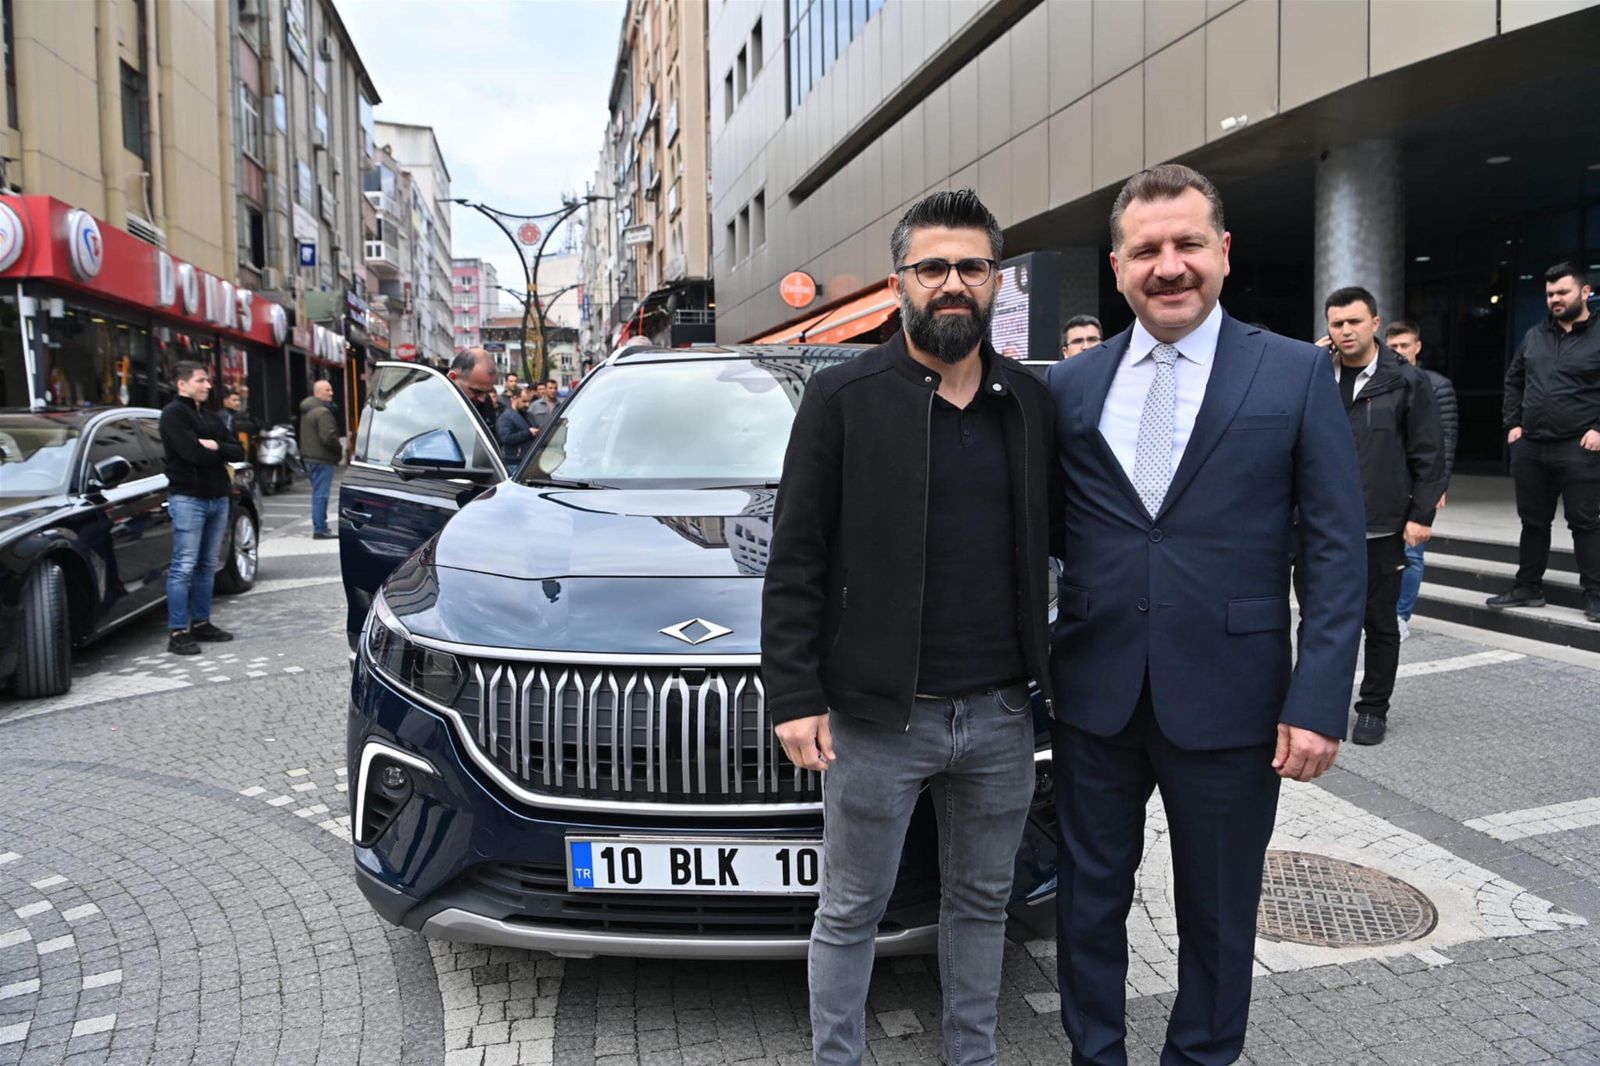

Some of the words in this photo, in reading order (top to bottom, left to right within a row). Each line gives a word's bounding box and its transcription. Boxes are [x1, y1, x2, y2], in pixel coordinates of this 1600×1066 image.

[575, 867, 592, 879] TR
[600, 846, 643, 884] 10
[669, 847, 740, 886] BLK
[775, 848, 819, 886] 10
